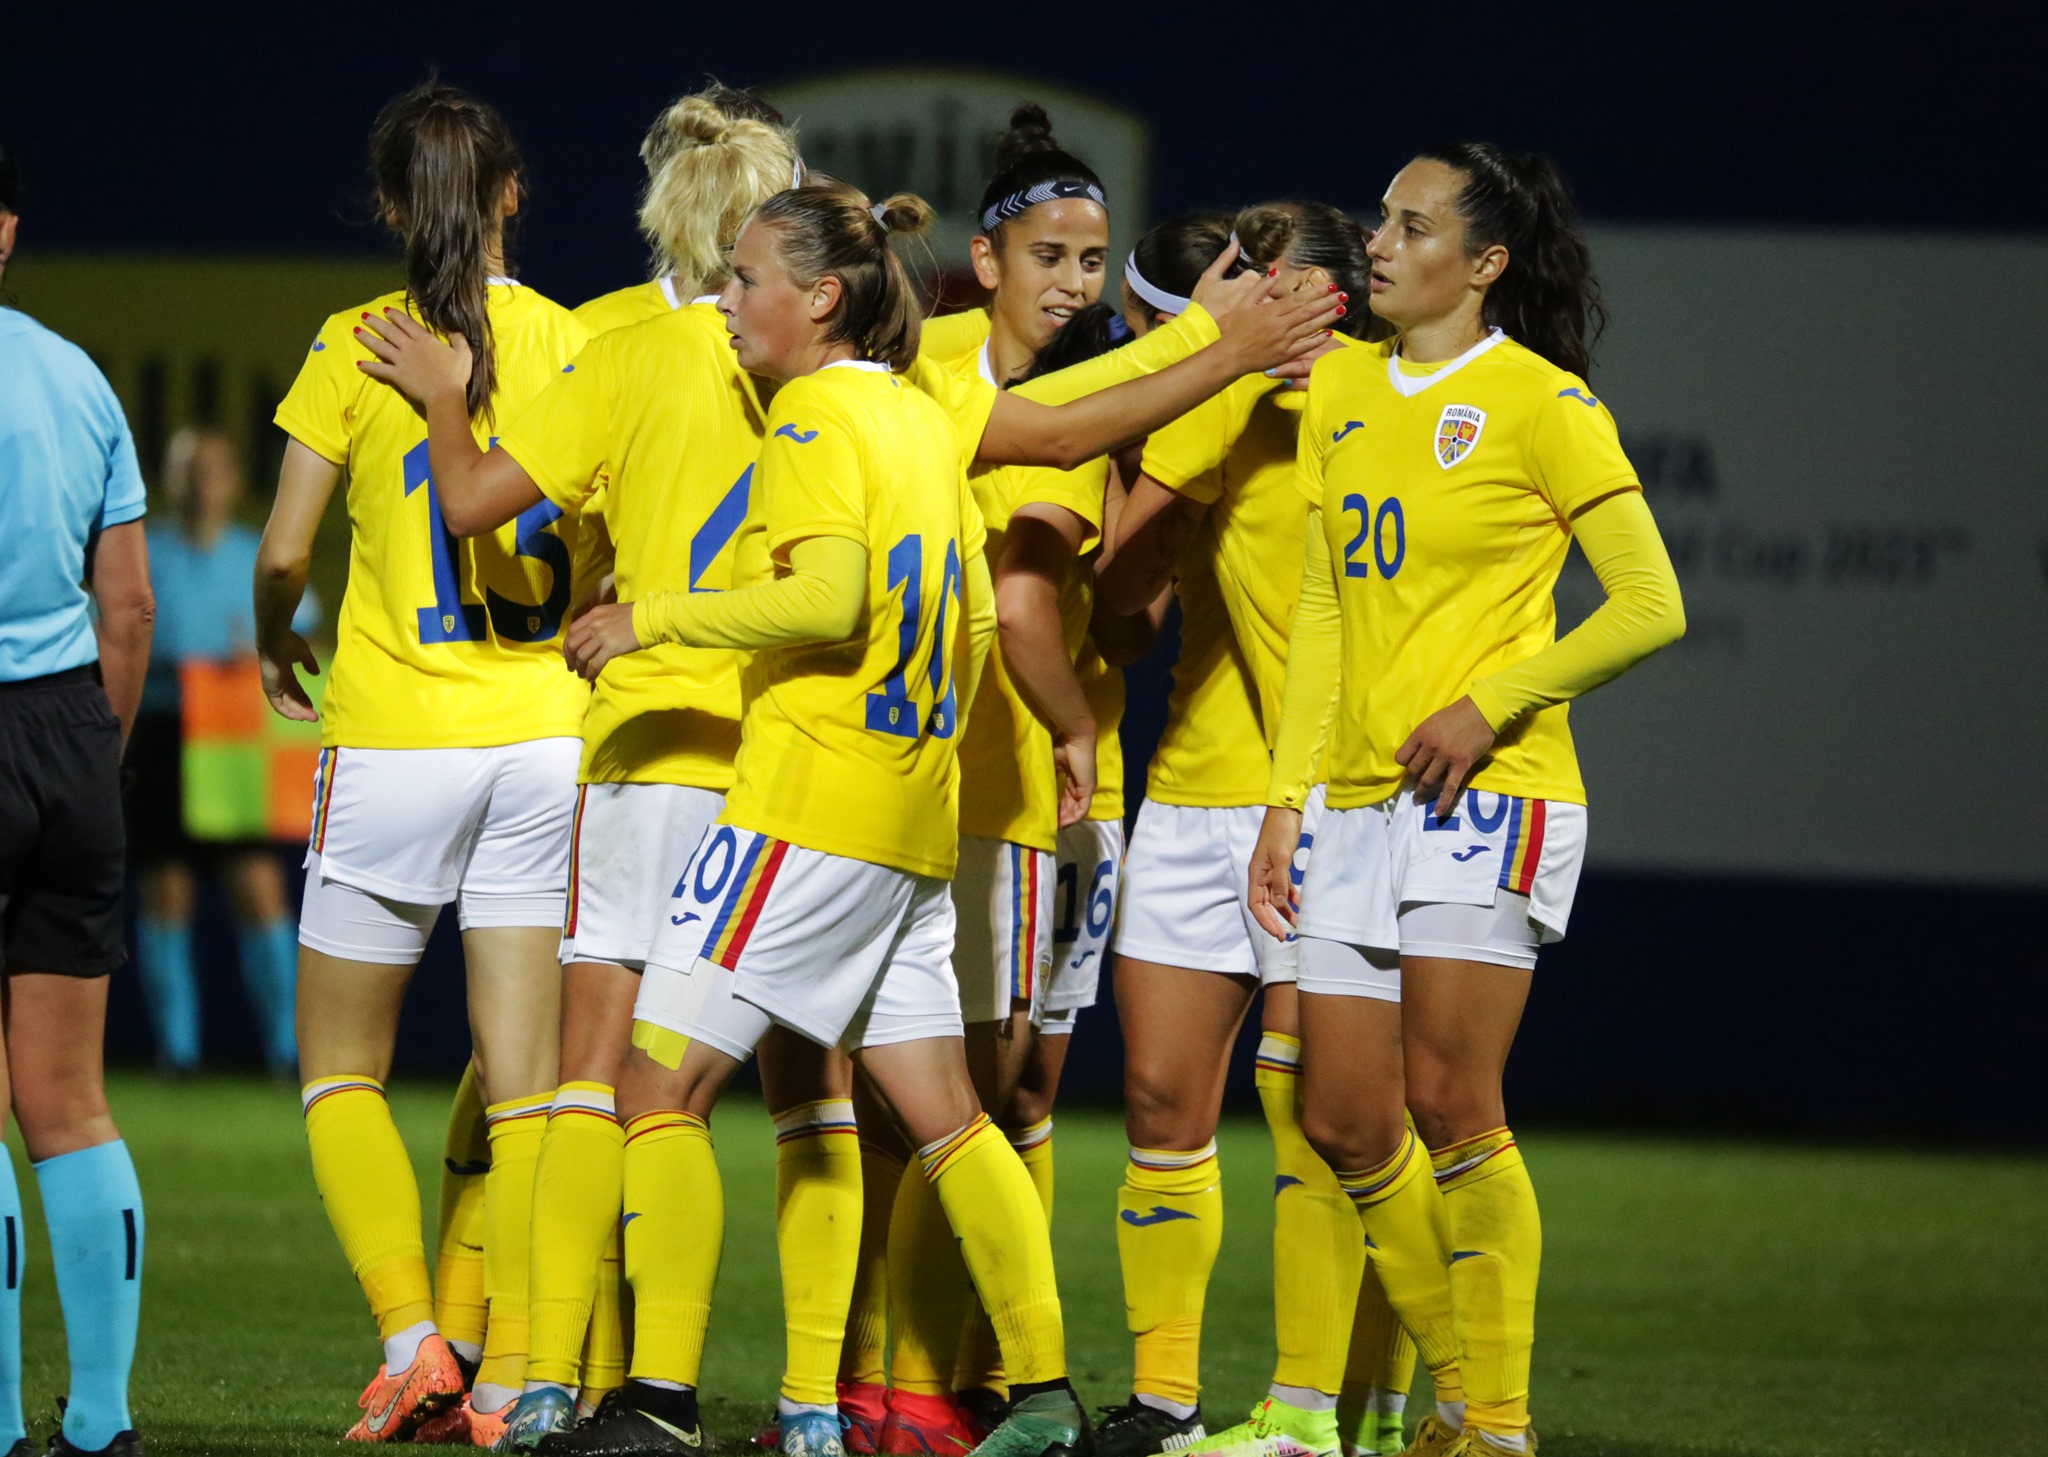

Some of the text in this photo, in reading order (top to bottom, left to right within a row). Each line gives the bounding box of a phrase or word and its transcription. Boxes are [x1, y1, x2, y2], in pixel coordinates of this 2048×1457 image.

[1446, 406, 1480, 423] ROMÂNIA
[1342, 493, 1405, 580] 20
[865, 534, 961, 739] 10
[1054, 860, 1112, 943] 16
